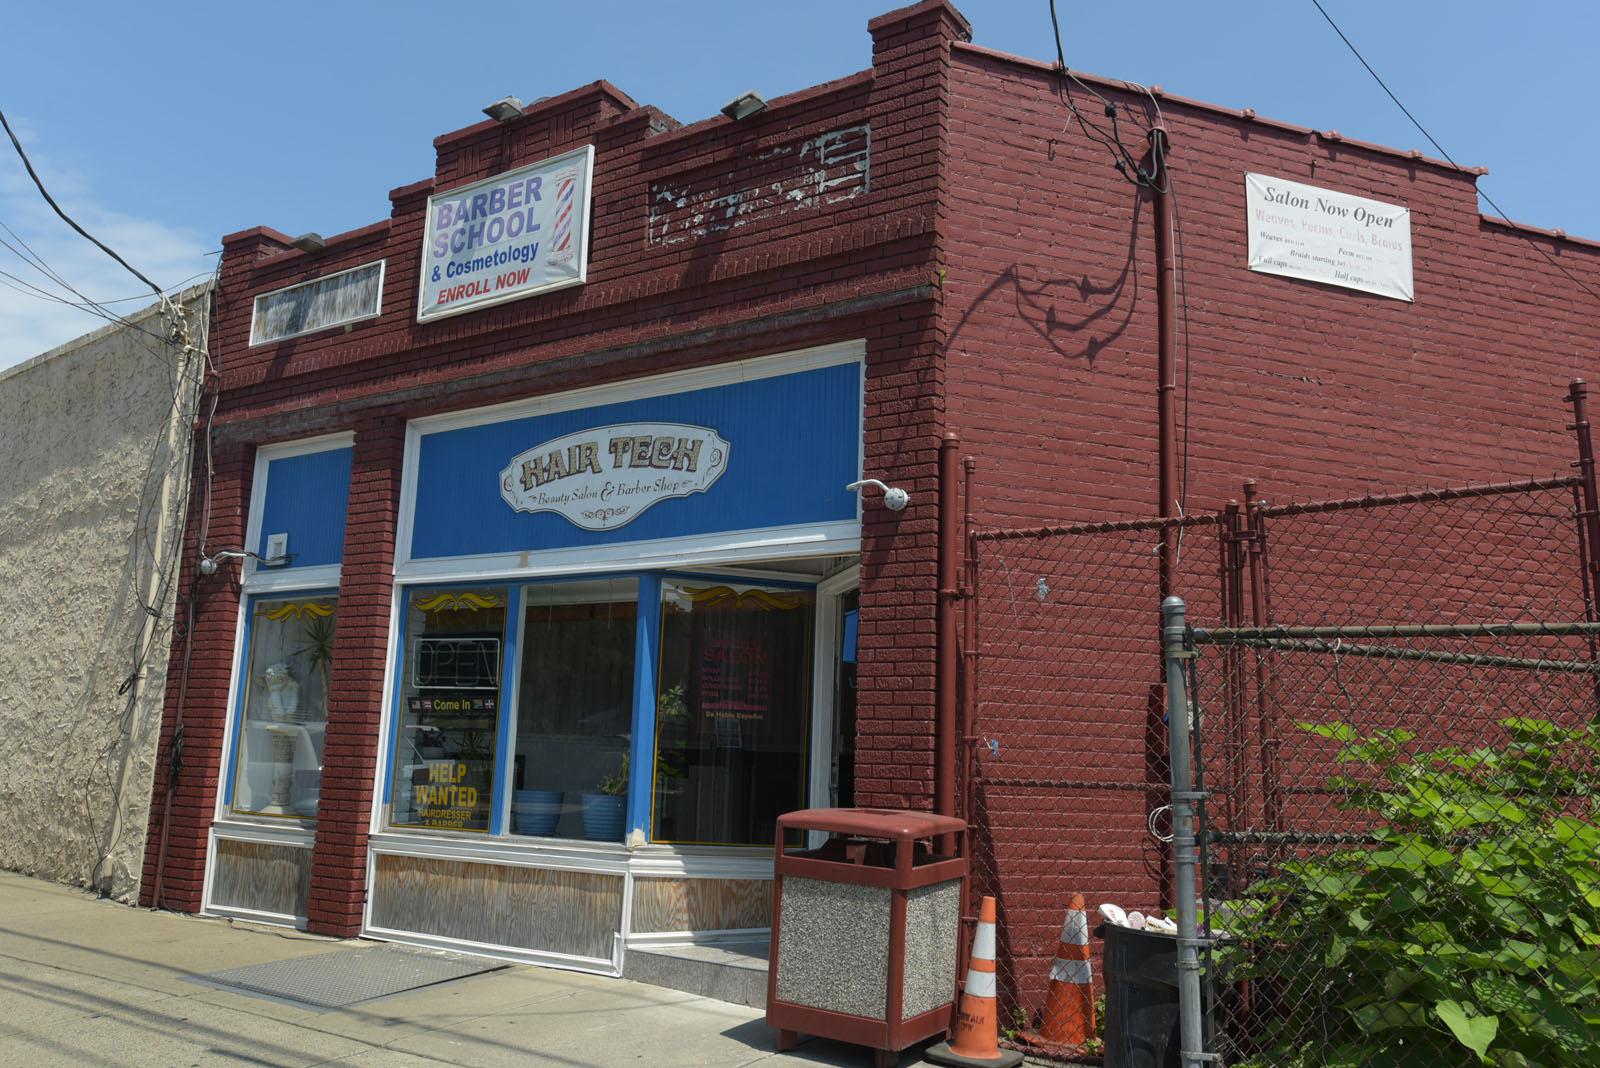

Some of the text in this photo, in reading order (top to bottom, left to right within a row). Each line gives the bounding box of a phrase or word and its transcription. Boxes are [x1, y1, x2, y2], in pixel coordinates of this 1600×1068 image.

[436, 176, 543, 231] BARBER
[1264, 186, 1393, 228] Salon Now Open
[433, 206, 541, 258] SCHOOL
[1260, 231, 1283, 243] Weaves
[1371, 233, 1403, 252] Braids
[431, 241, 540, 282] & Cosmetology
[1290, 249, 1311, 260] Braids
[436, 267, 532, 305] ENROLL NOW
[1334, 270, 1349, 281] Half
[520, 434, 704, 492] HAIR TECH
[537, 477, 680, 505] Beauty Salon & Barber Shop
[416, 641, 498, 686] OPEN
[433, 699, 471, 710] Come In
[429, 763, 467, 784] HELP
[415, 785, 477, 808] WANTED
[418, 808, 472, 821] HAIRDRESSER
